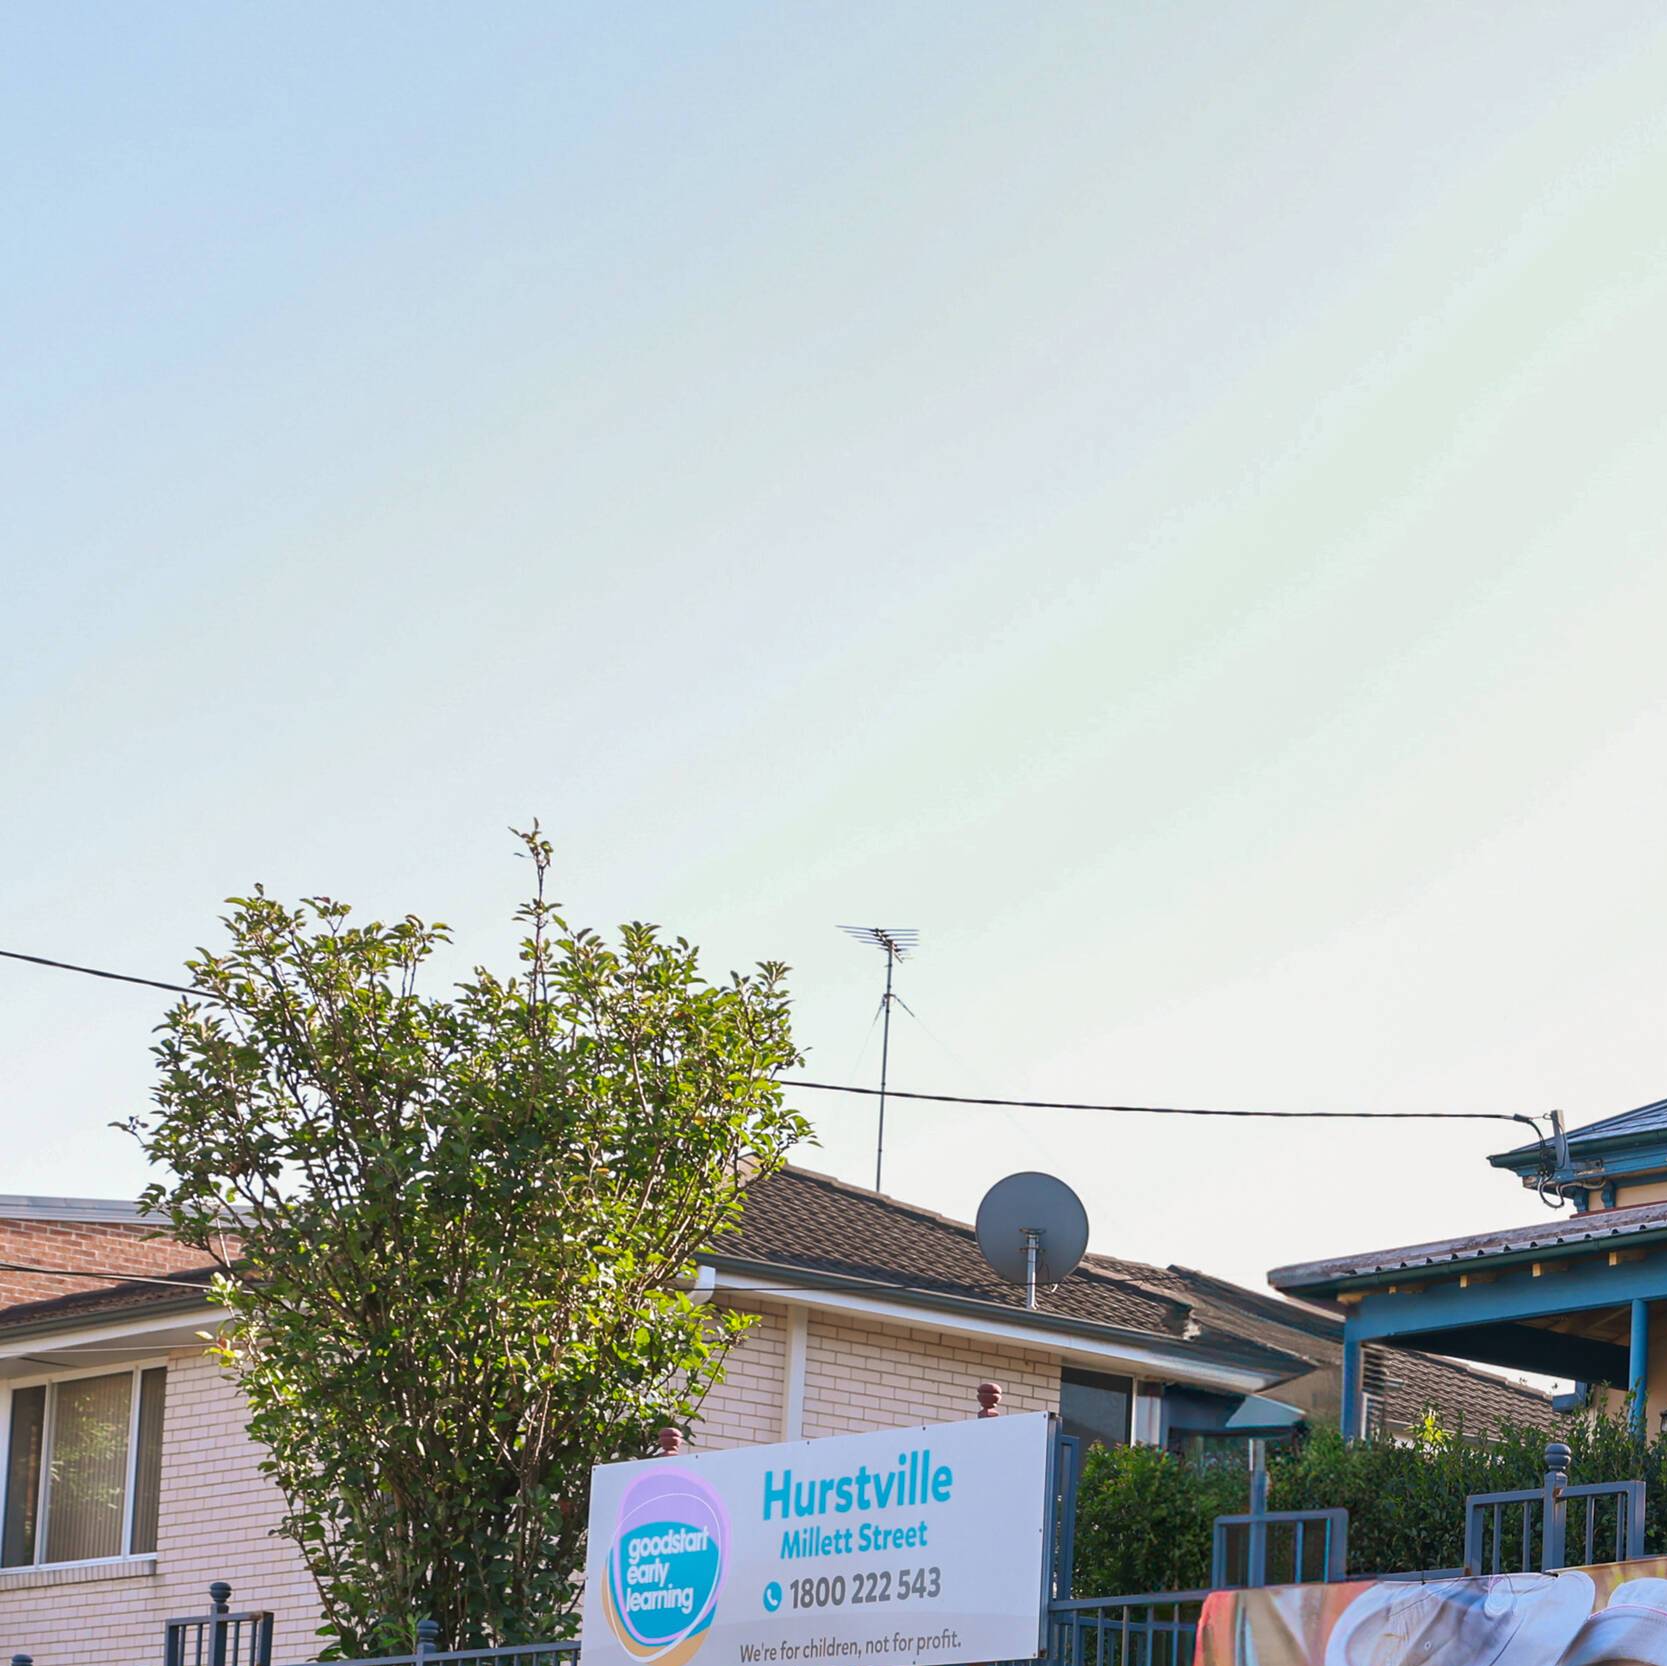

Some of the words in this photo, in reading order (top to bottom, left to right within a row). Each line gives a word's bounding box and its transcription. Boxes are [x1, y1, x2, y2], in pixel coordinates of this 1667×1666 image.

[762, 1449, 952, 1520] Hurstville
[628, 1525, 710, 1564] goodstart
[781, 1527, 852, 1560] Millett
[858, 1520, 928, 1552] Street
[626, 1559, 670, 1590] early
[790, 1575, 845, 1608] 1800
[852, 1572, 891, 1605] 222
[897, 1567, 941, 1599] 543
[625, 1583, 694, 1614] learning
[739, 1643, 777, 1663] We're
[780, 1639, 800, 1660] for
[802, 1638, 861, 1659] children,
[865, 1636, 889, 1654] not
[892, 1632, 913, 1653] for
[916, 1630, 962, 1656] profit.
